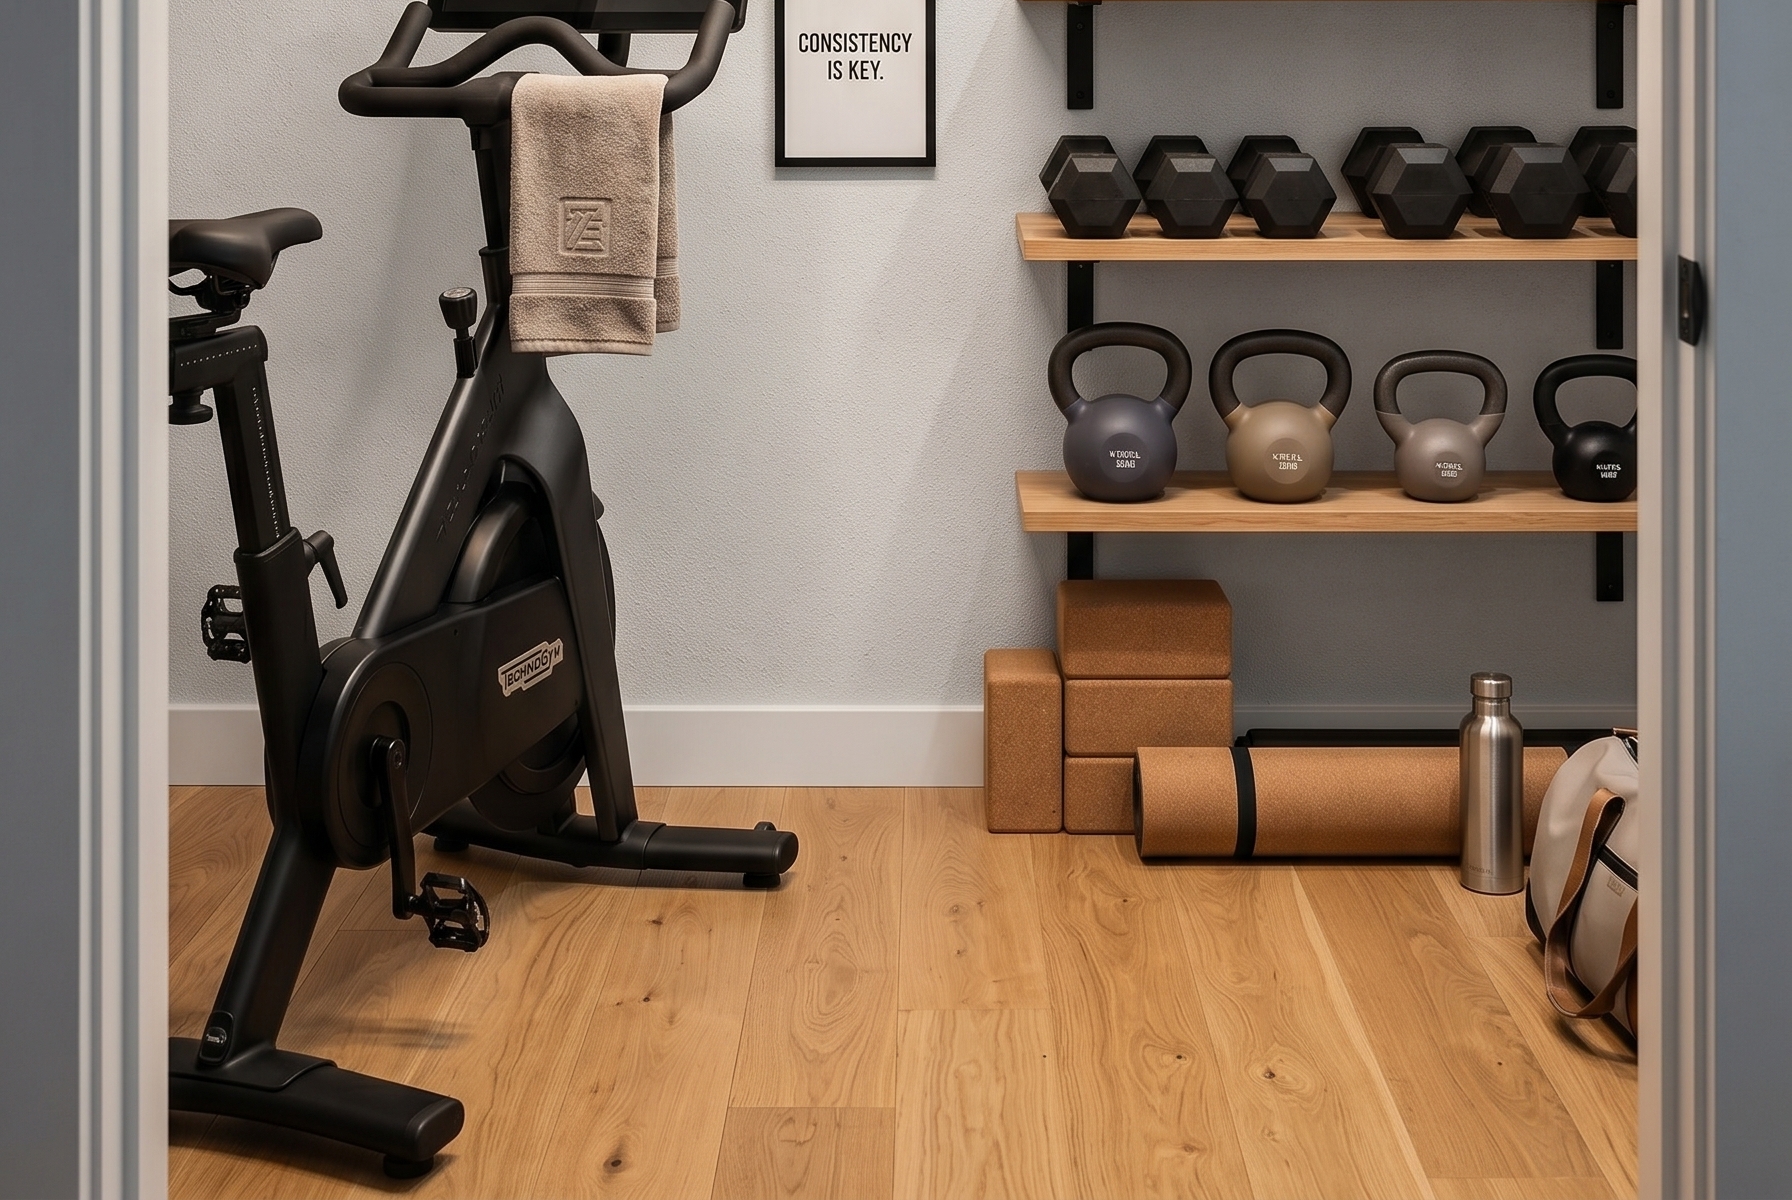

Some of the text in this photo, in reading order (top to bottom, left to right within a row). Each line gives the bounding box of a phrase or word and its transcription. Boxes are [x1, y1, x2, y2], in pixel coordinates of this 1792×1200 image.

[798, 32, 912, 53] CONSISTENCY
[828, 60, 884, 80] IS KEY.
